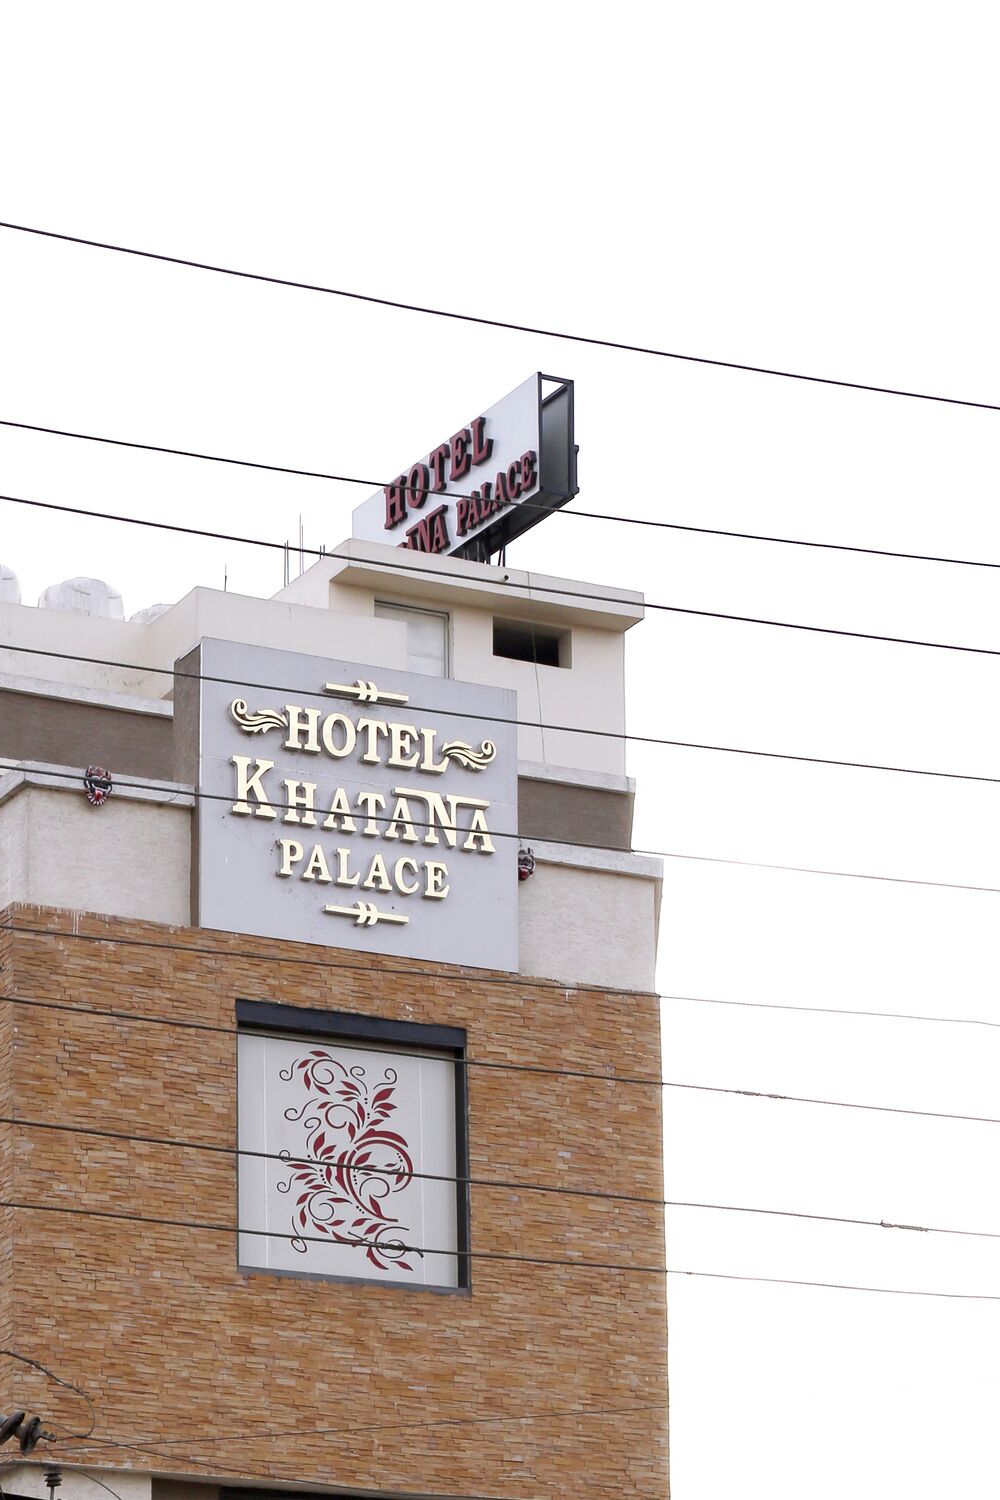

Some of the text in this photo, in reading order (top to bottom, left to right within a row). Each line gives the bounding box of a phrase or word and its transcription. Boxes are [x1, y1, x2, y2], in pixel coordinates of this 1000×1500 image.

[384, 416, 494, 530] HOTEL
[456, 450, 537, 536] PALACE
[282, 704, 450, 774] HOTEL
[229, 754, 497, 854] KHATANA
[276, 838, 451, 899] PALACE
